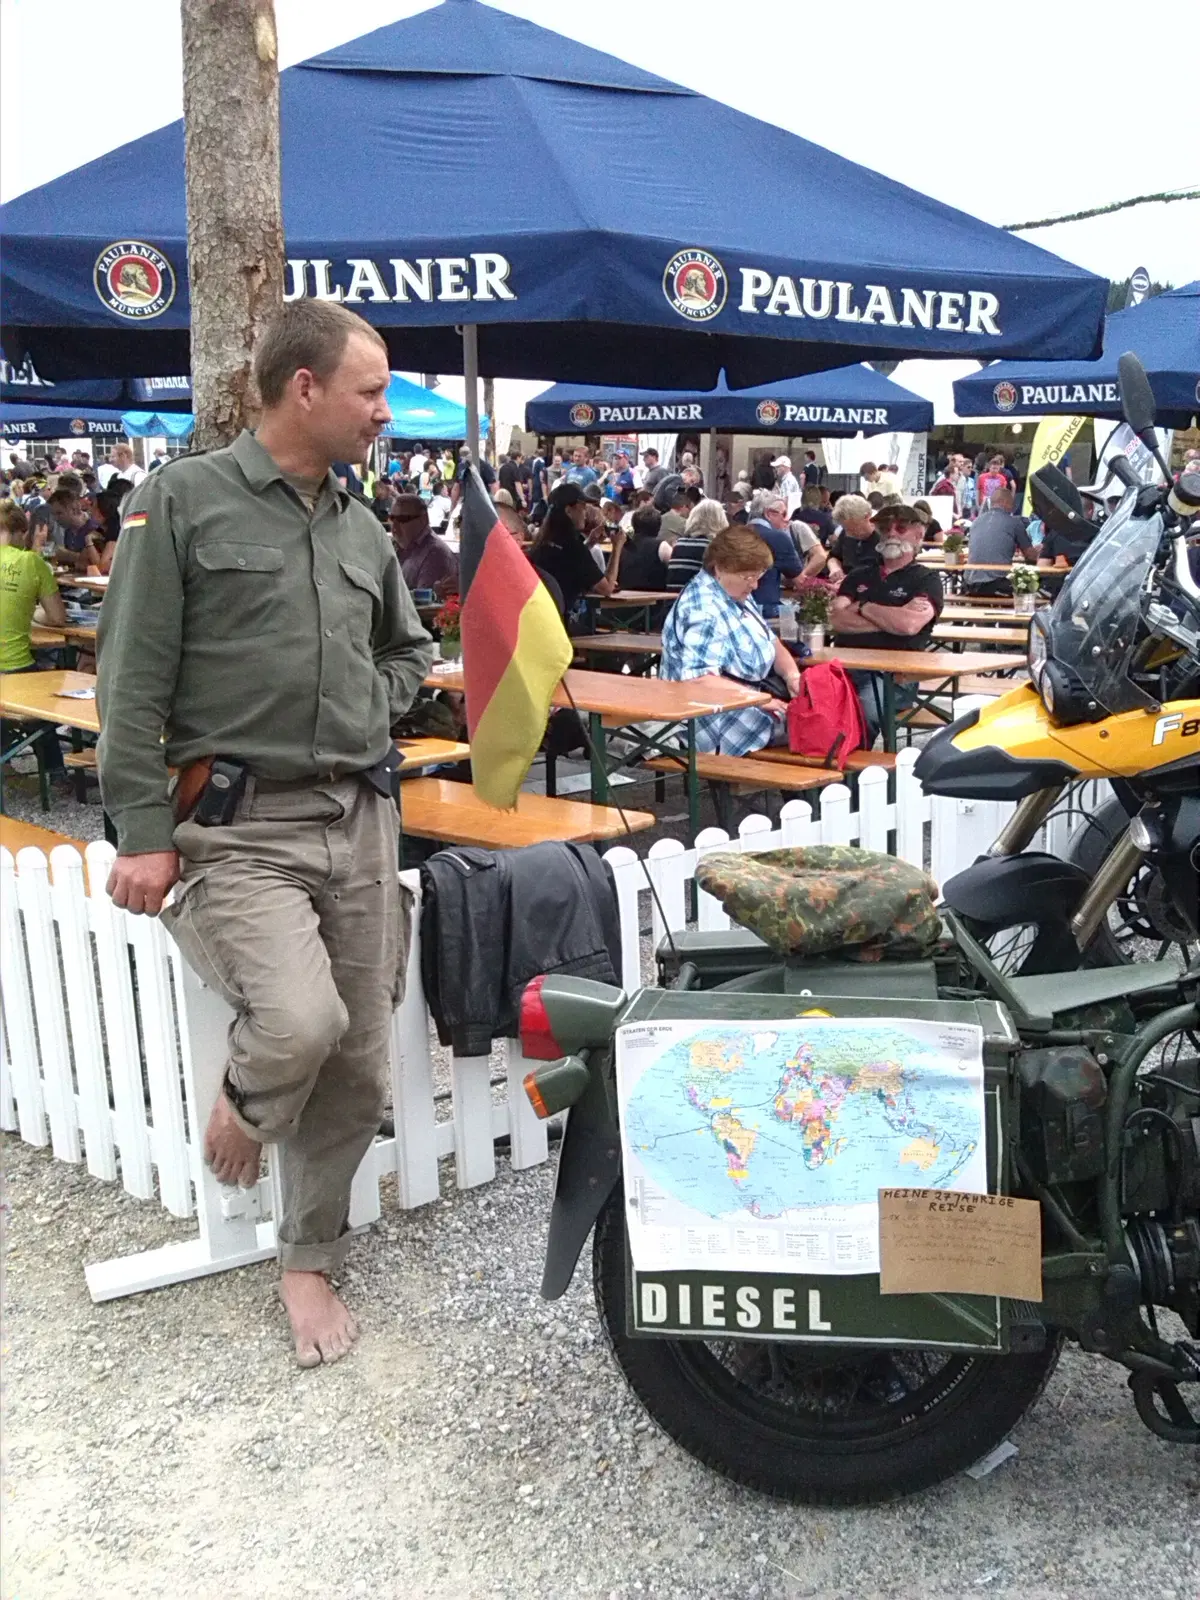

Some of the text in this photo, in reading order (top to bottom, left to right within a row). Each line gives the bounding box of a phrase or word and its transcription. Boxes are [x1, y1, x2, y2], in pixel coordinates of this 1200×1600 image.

[98, 245, 166, 272] PAULANER
[668, 253, 722, 280] PAULANER
[283, 253, 517, 303] ULANER
[738, 267, 1003, 336] PAULANER
[1021, 384, 1121, 404] PAULANE
[598, 404, 703, 422] PAULANER
[784, 404, 888, 425] PAULANER
[3, 422, 37, 434] ANER
[1041, 444, 1053, 460] DER
[883, 1189, 930, 1199] MEINE
[928, 1202, 976, 1213] REISE
[641, 1282, 832, 1331] DIESEL
